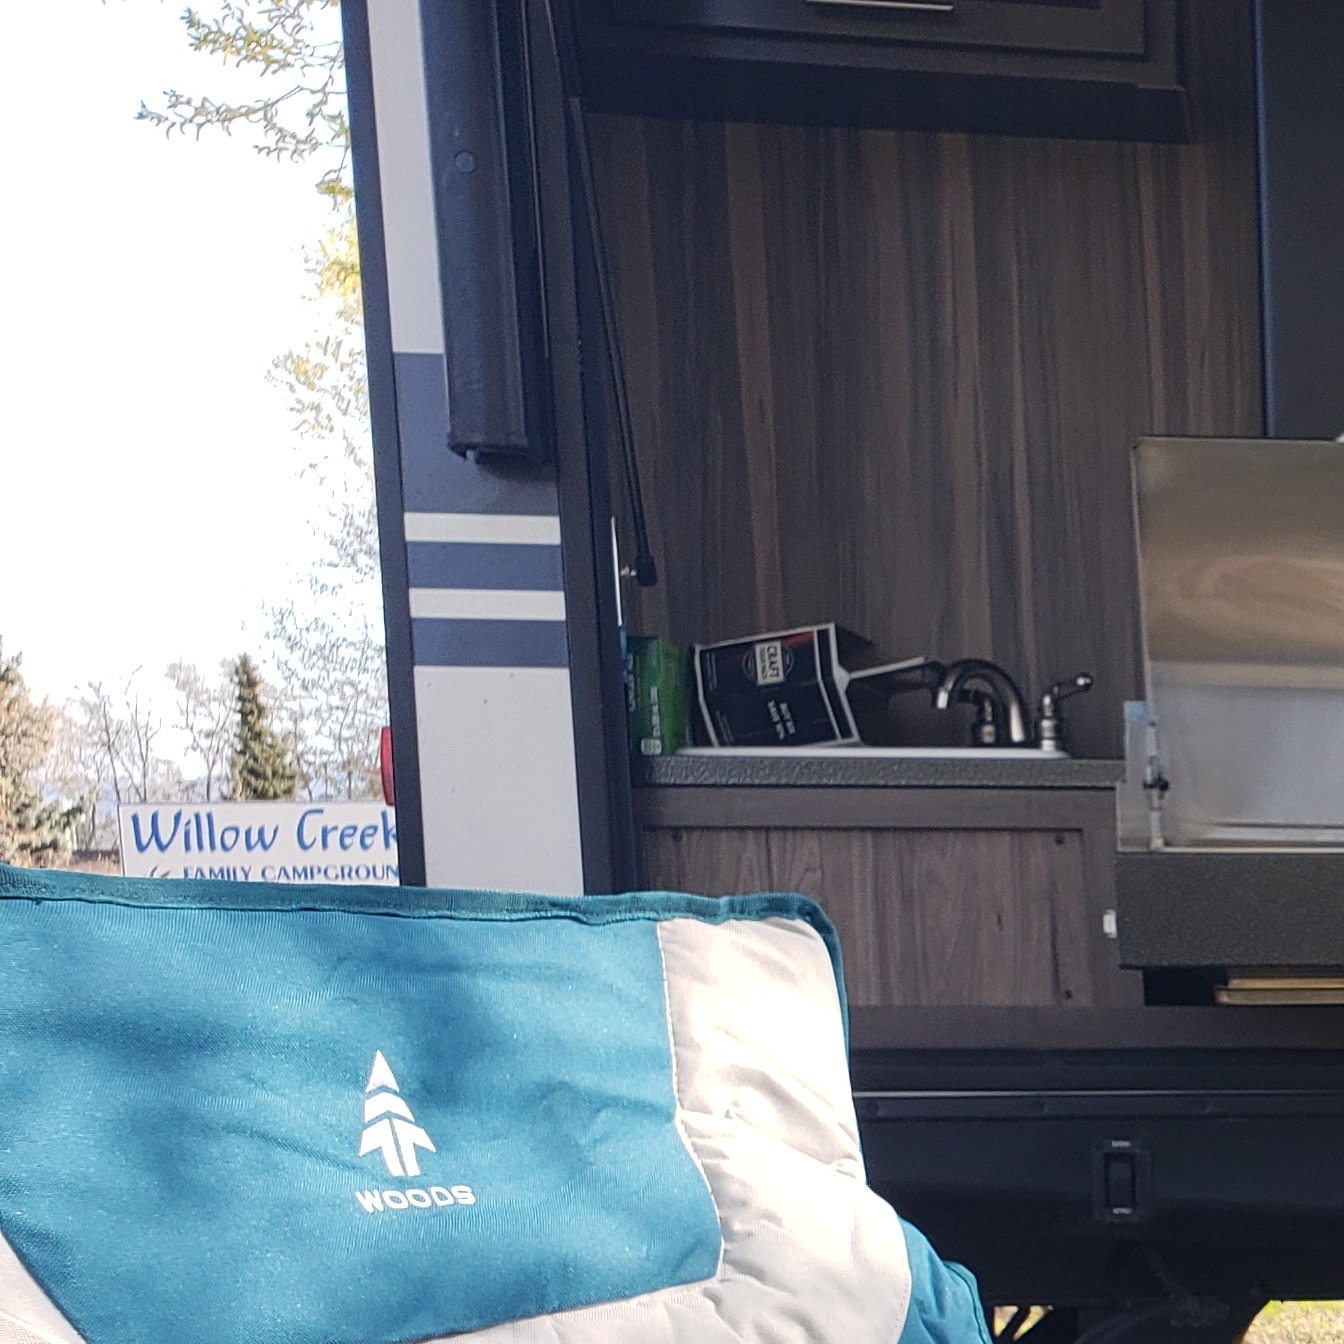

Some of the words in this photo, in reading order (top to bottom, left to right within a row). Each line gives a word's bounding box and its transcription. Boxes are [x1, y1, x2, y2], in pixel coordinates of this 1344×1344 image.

[131, 808, 279, 854] Willow
[296, 808, 398, 853] Creek
[183, 865, 252, 881] FAMILY
[354, 1185, 476, 1214] WOODS
